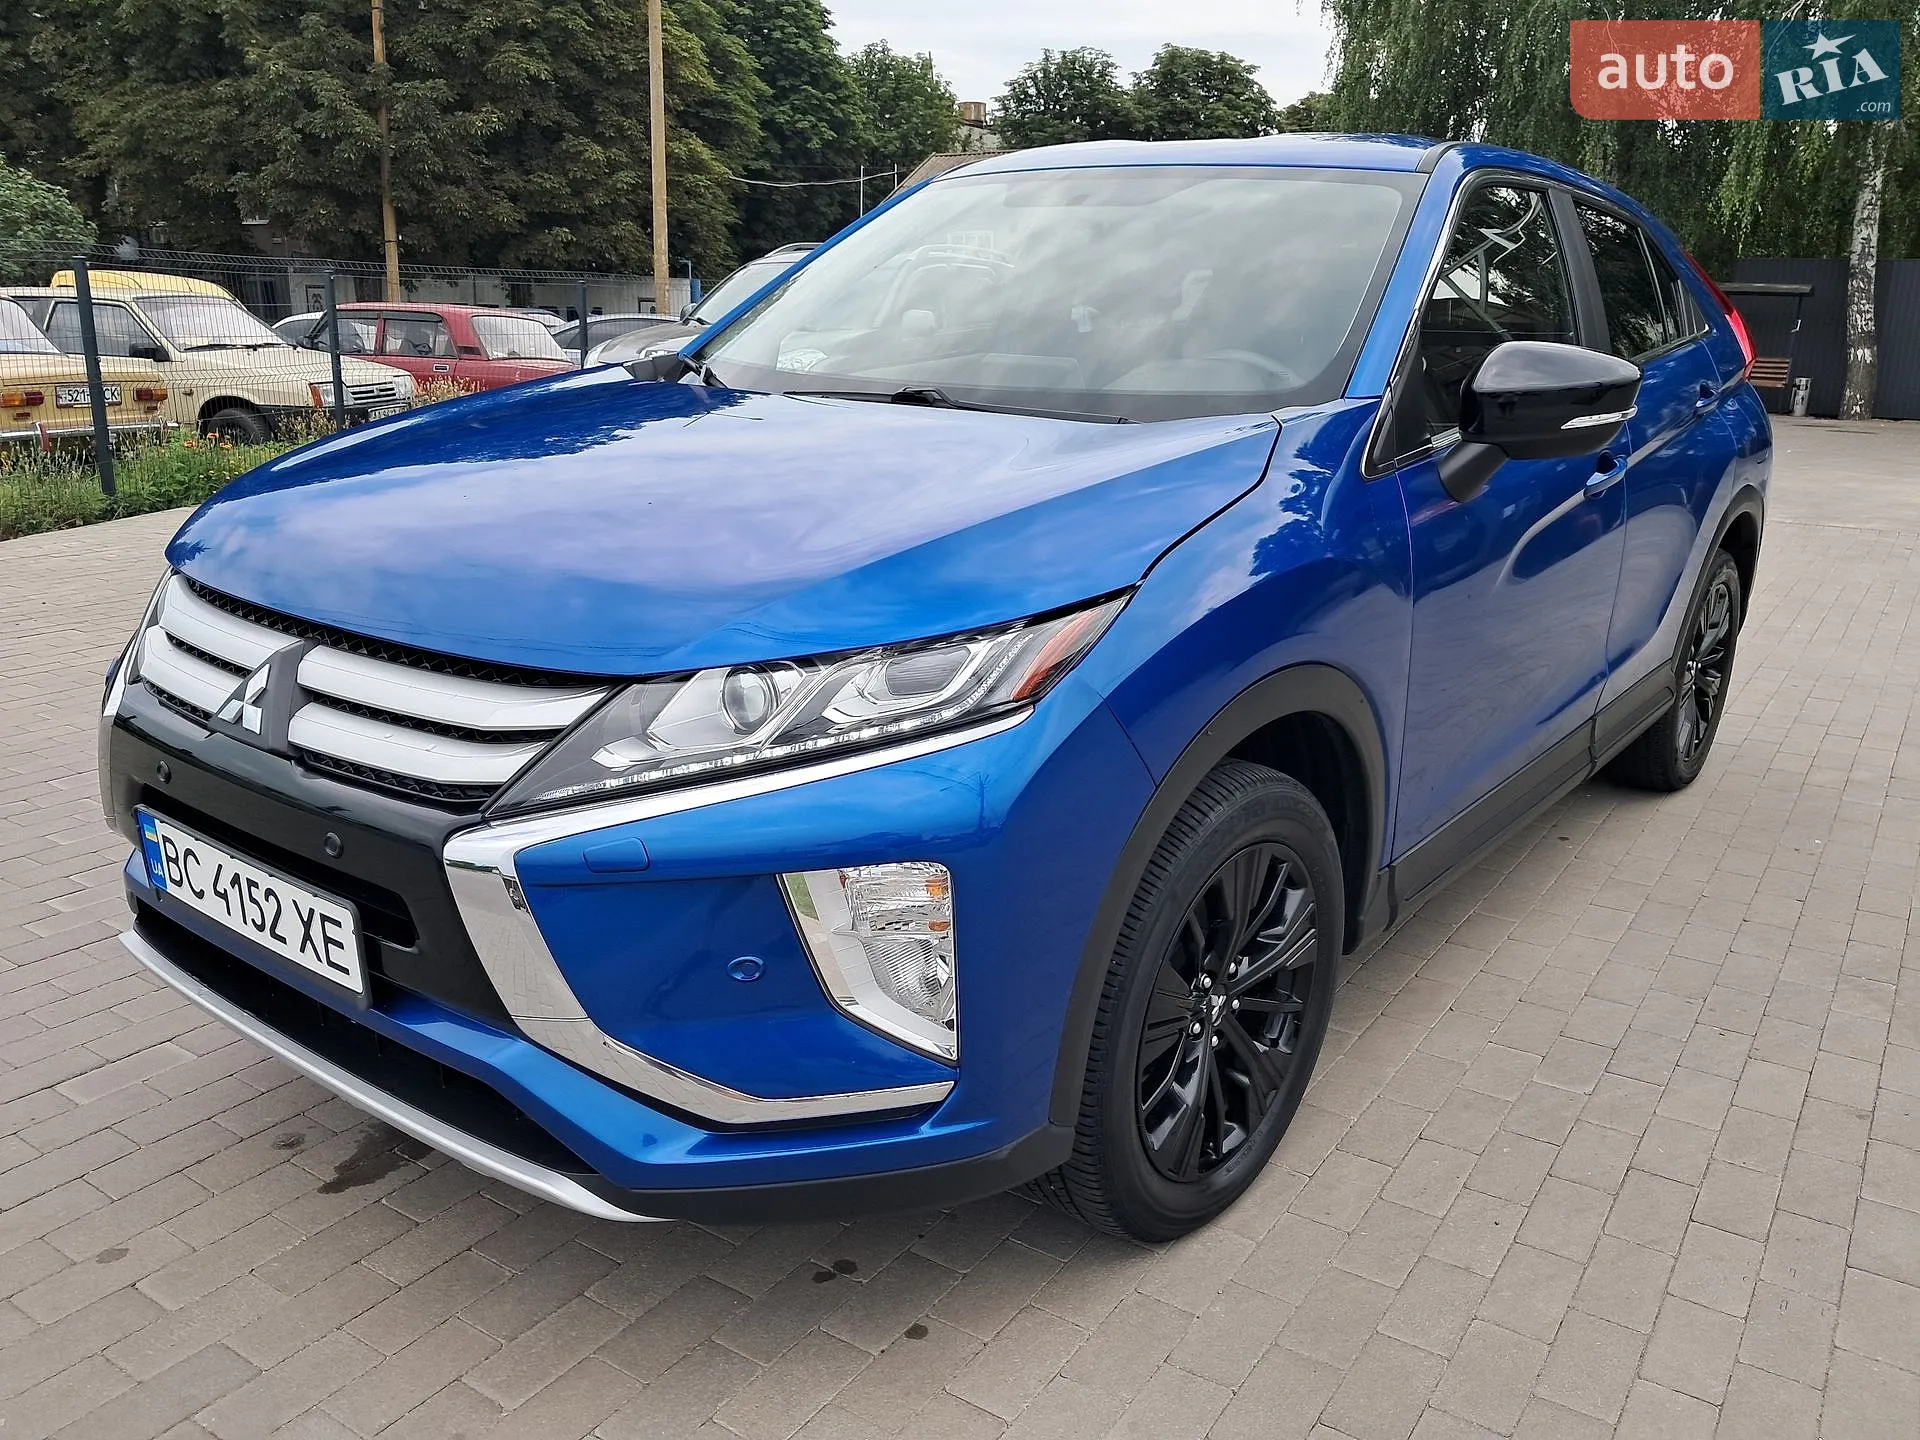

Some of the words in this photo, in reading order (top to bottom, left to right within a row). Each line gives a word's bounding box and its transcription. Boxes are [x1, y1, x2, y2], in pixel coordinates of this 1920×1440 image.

[150, 858, 165, 879] UA
[161, 833, 205, 900] BC
[212, 863, 288, 946] 4152
[291, 898, 350, 976] XE
